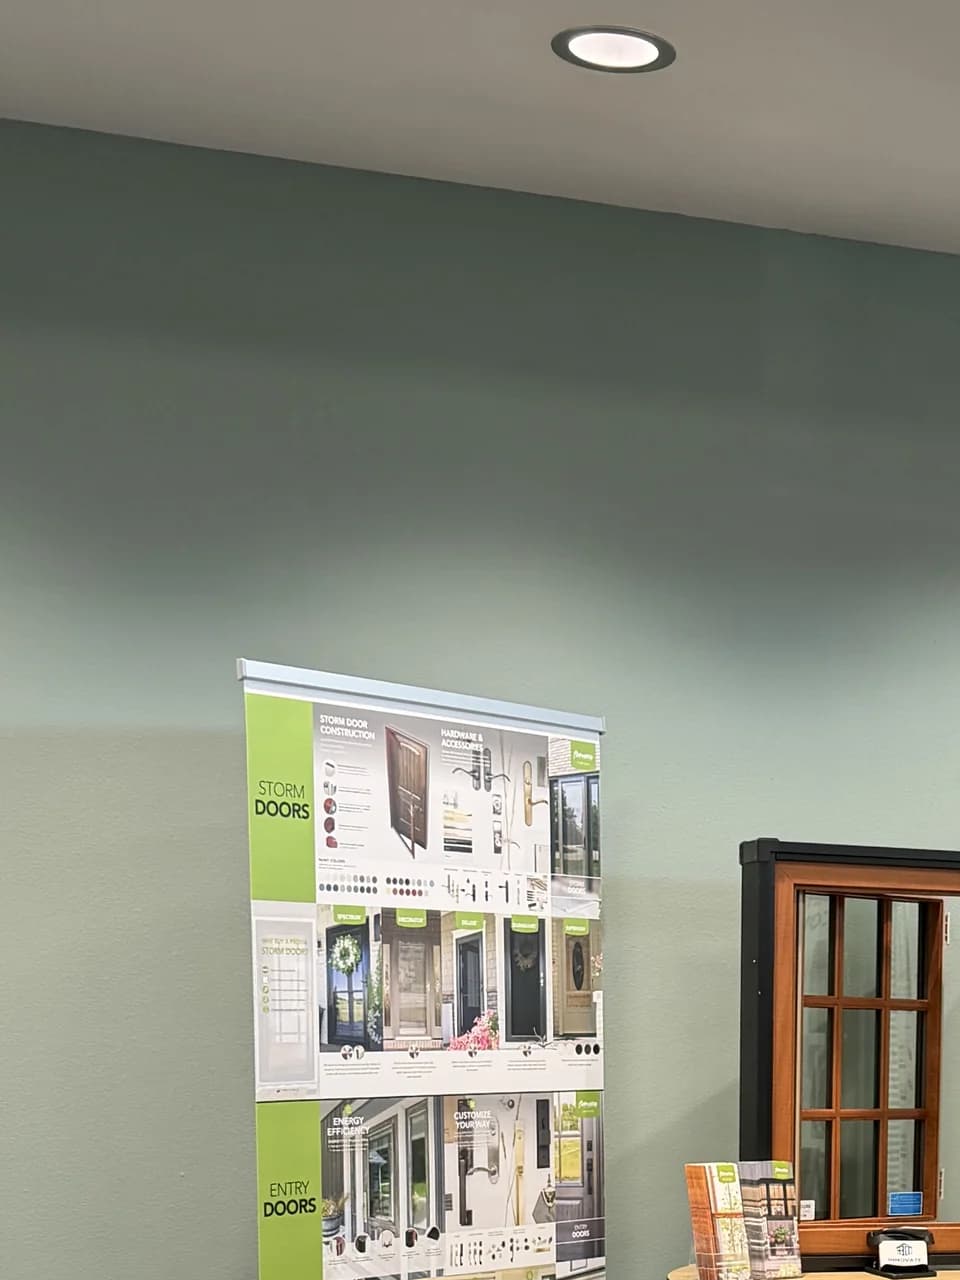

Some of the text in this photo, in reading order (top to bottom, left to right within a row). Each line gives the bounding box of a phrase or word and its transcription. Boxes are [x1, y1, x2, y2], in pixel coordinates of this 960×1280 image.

[320, 714, 369, 729] STORM DOOR
[320, 725, 376, 740] CONSTRUCTION
[258, 780, 305, 799] STORM
[255, 799, 310, 820] DOORS
[333, 1116, 364, 1126] ENERGY
[453, 1110, 492, 1120] CUSTOMIZE
[455, 1119, 490, 1129] YOUR WAY
[270, 1180, 309, 1197] ENTRY
[263, 1197, 317, 1218] DOORS
